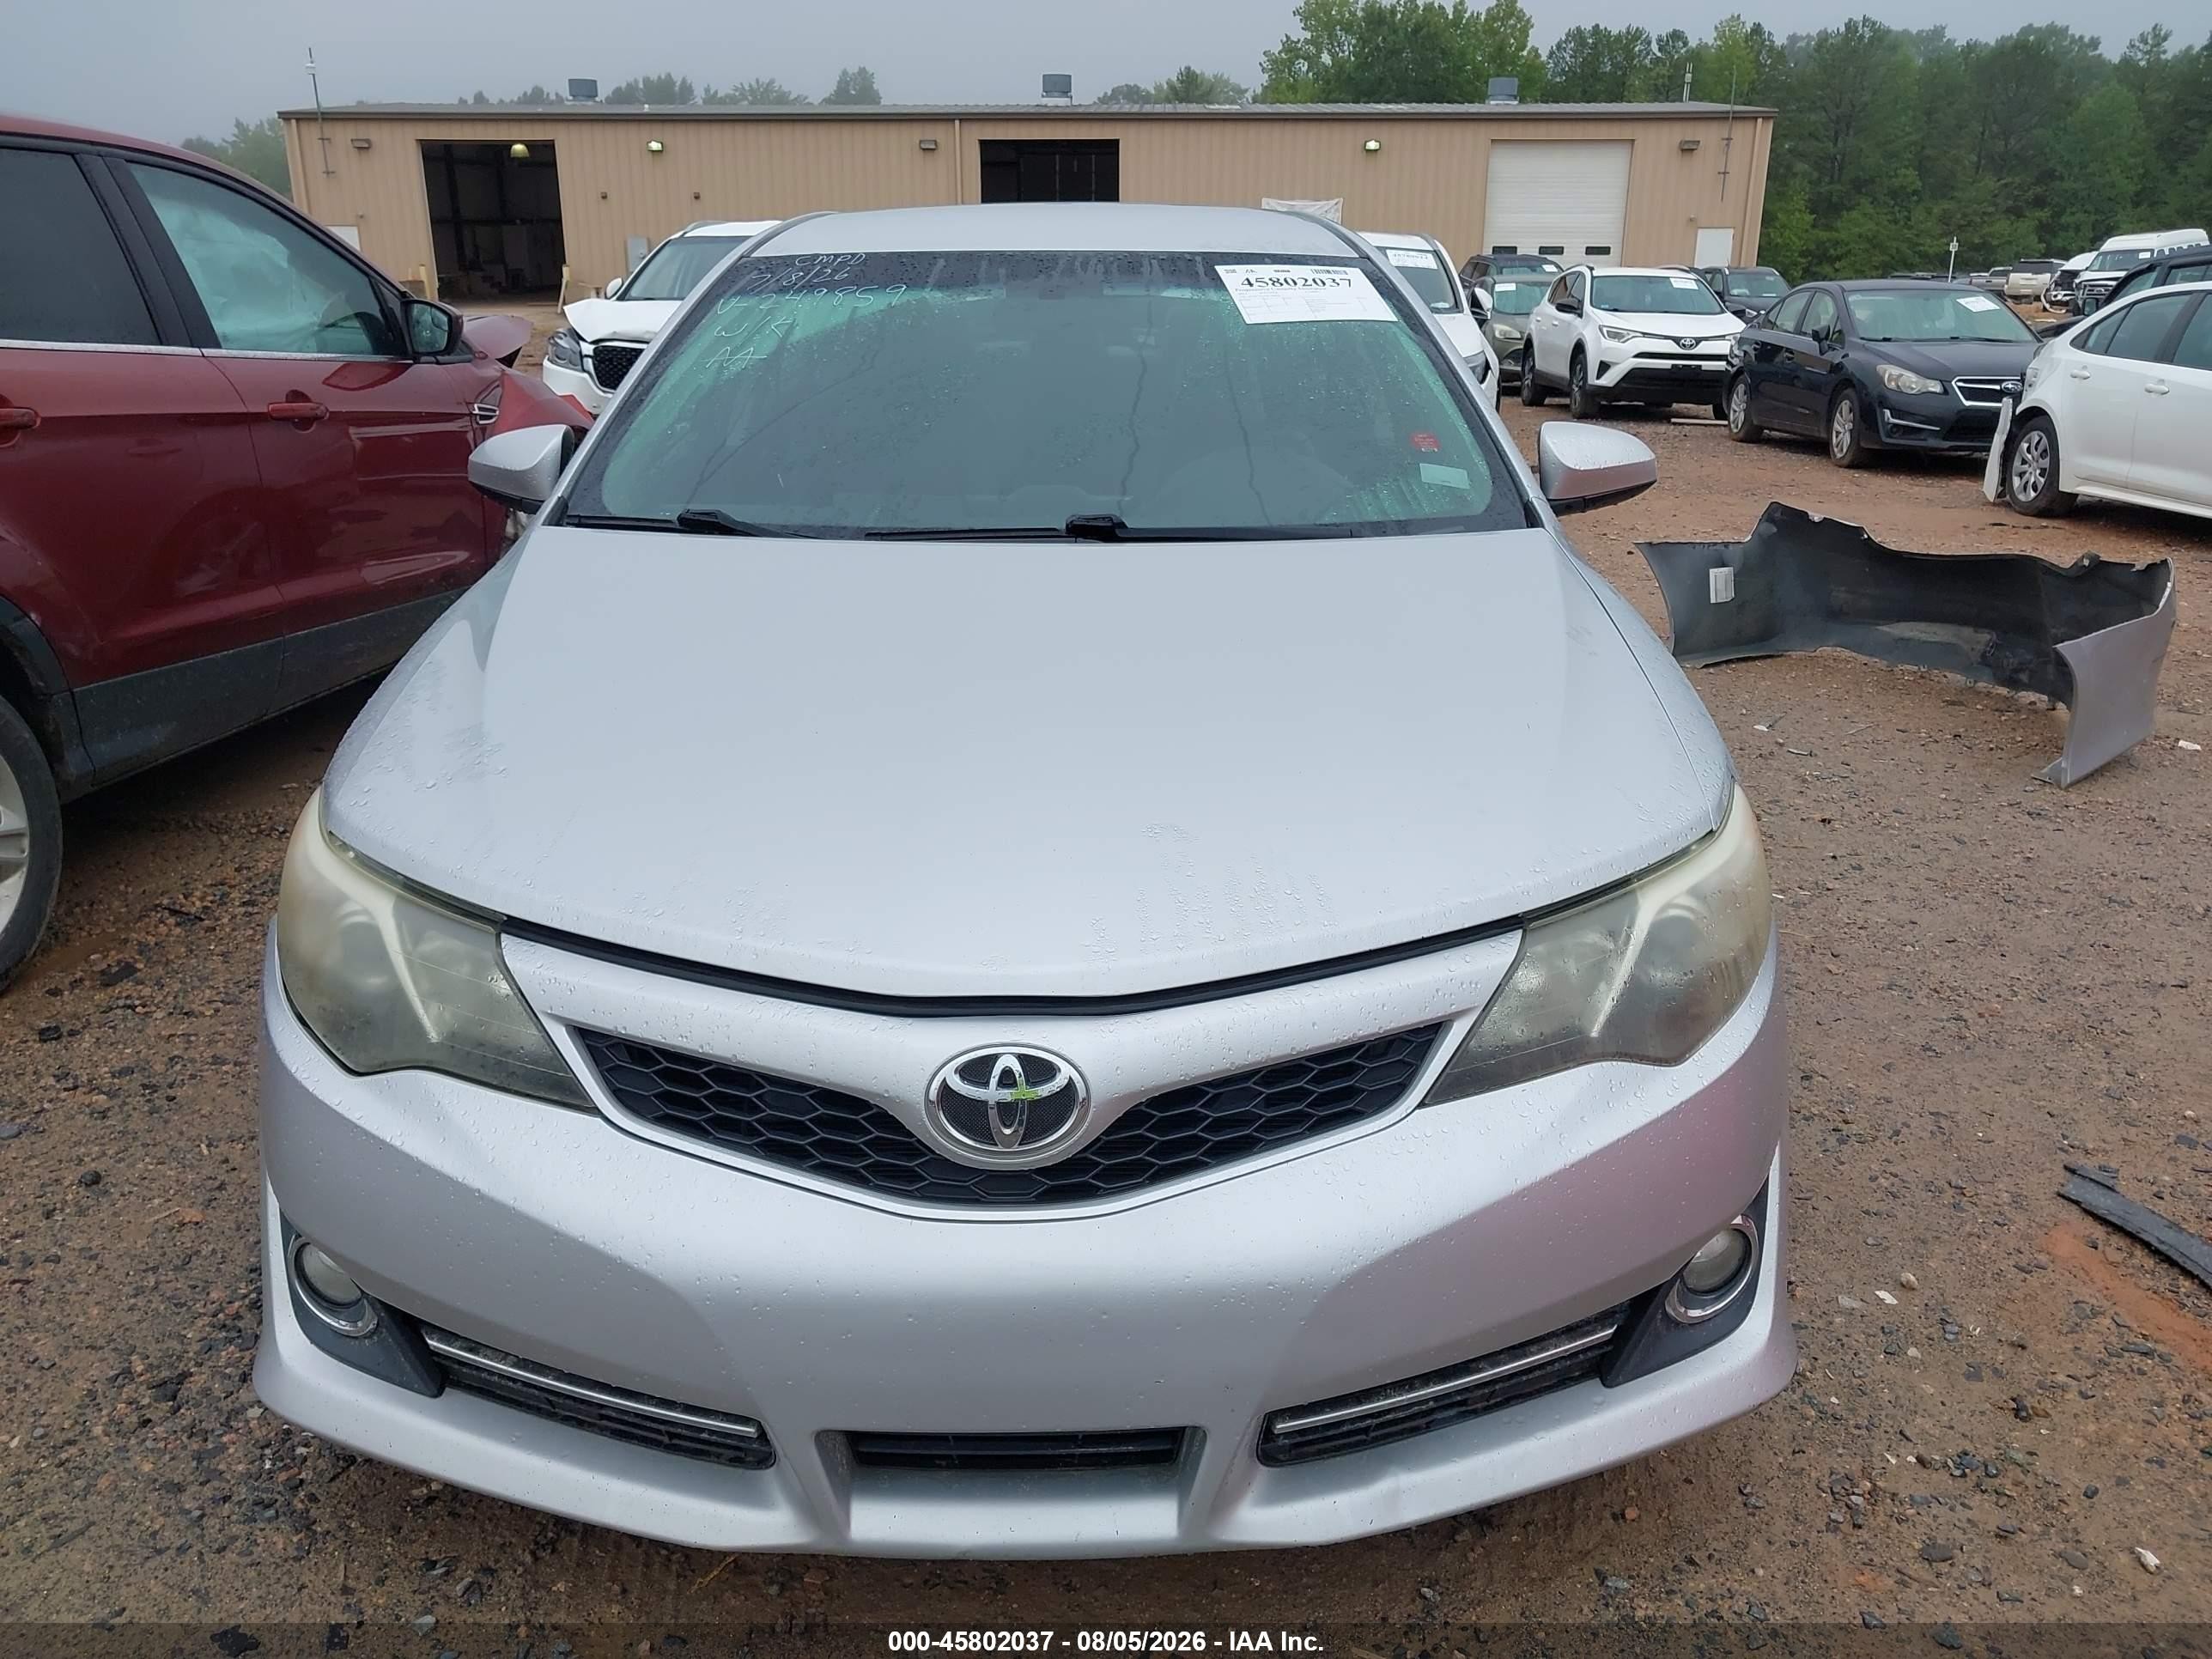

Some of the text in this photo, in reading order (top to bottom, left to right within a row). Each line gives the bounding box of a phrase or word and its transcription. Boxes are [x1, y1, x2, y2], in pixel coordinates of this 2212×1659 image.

[795, 252, 866, 266] CMPD
[747, 266, 851, 295] 7/8/26
[1241, 276, 1352, 288] 45802037
